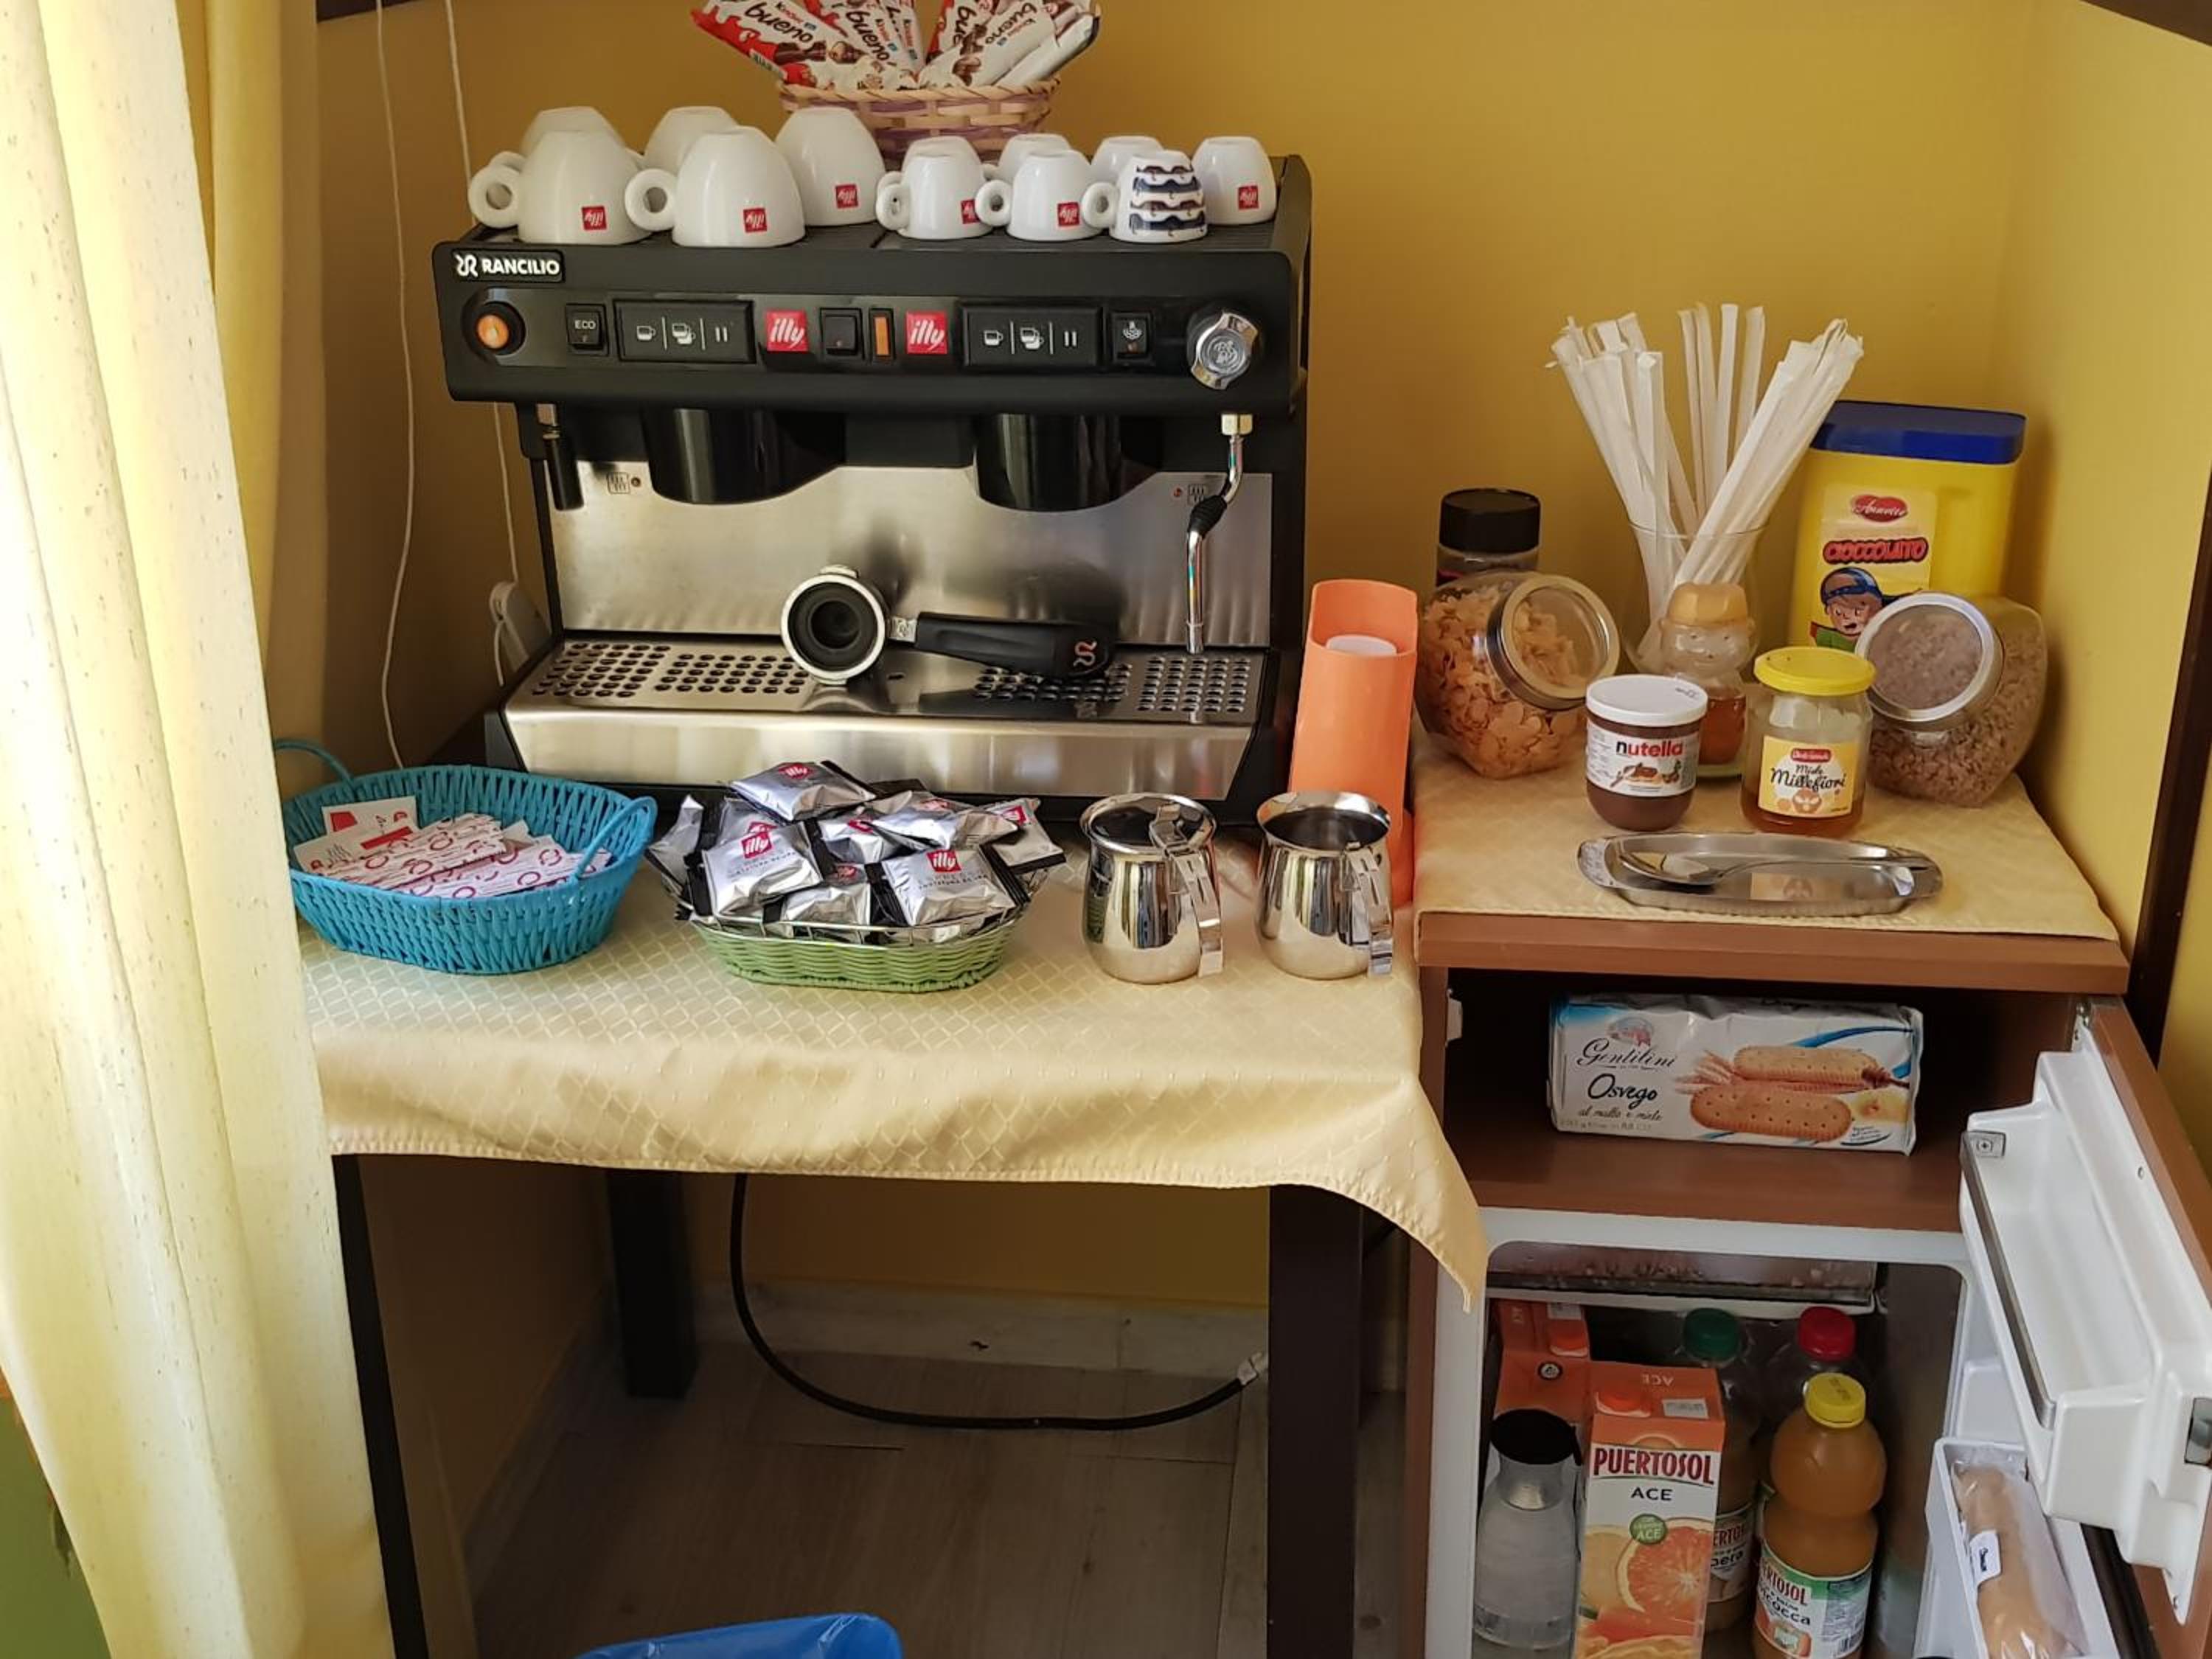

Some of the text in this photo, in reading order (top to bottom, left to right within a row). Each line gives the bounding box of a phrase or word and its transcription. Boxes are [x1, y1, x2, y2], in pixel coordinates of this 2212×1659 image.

[744, 1, 814, 43] bueno
[846, 10, 891, 61] bueno
[583, 209, 605, 227] illy
[745, 212, 765, 229] illy
[481, 258, 560, 275] RANCILIO
[574, 319, 597, 330] ECO
[770, 318, 805, 347] illy
[908, 319, 945, 350] illy
[1615, 740, 1683, 757] nutella
[1770, 768, 1847, 793] Millefiori
[745, 836, 769, 855] illy
[933, 851, 956, 870] illy
[1576, 1037, 1676, 1067] Gentilini
[1587, 1073, 1658, 1110] Osvego
[1593, 1447, 1714, 1485] PUERTOSOL
[1630, 1486, 1673, 1501] ACE
